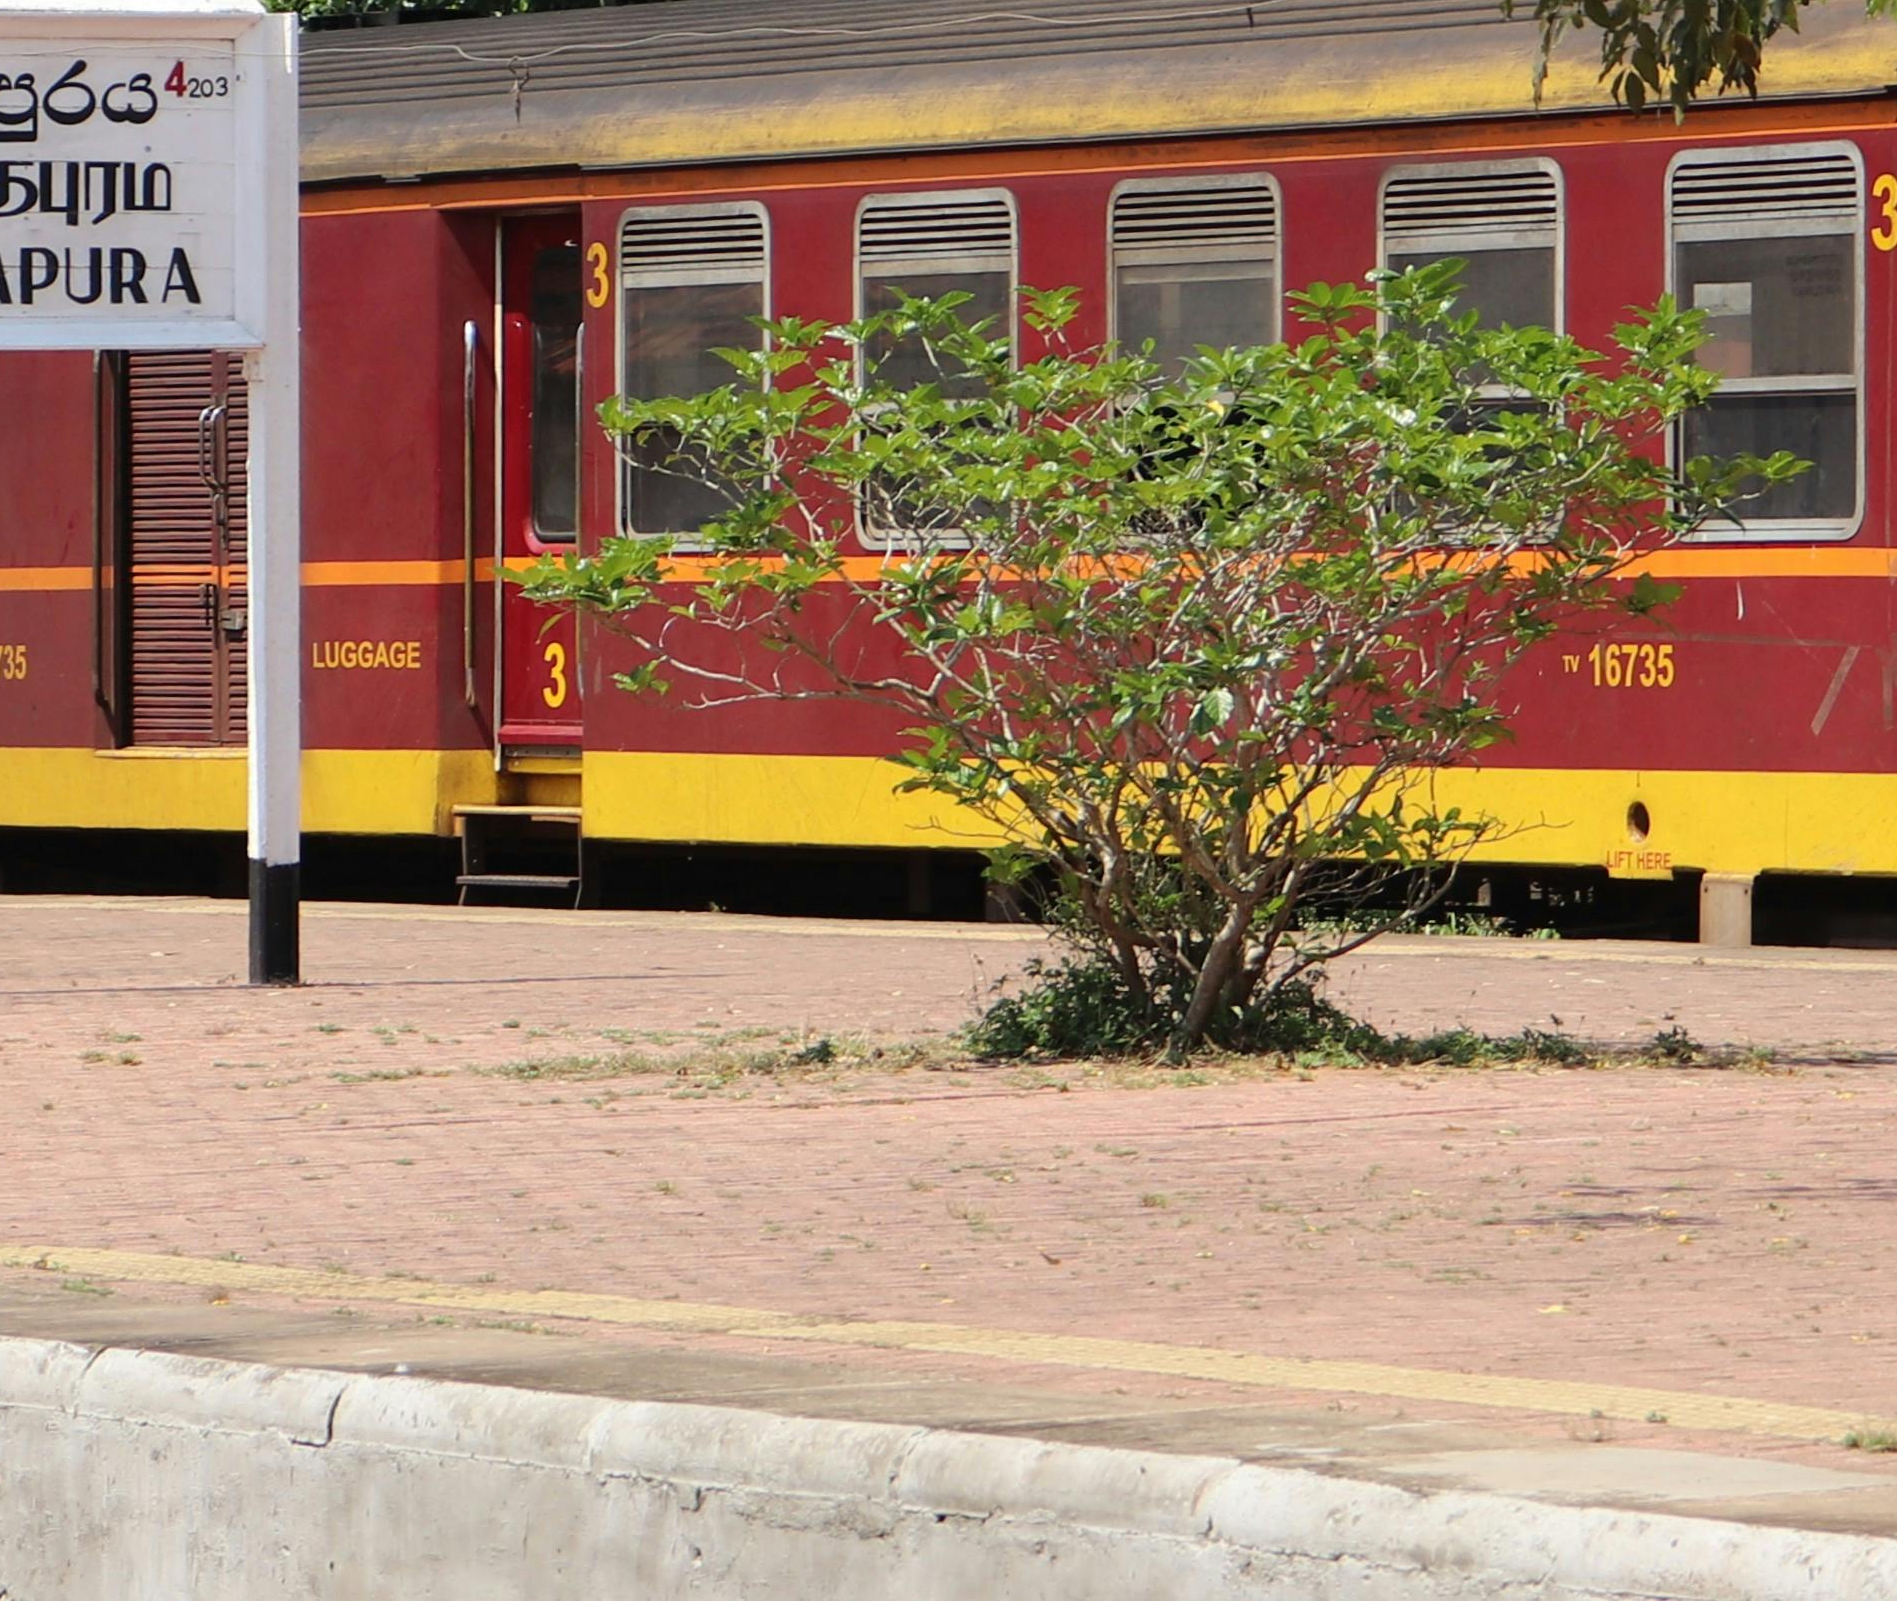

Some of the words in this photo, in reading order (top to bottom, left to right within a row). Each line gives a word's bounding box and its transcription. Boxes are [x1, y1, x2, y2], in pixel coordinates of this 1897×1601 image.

[586, 242, 609, 308] 3
[312, 640, 422, 669] LUGGAGE
[543, 642, 567, 708] 3
[1562, 654, 1581, 673] TV
[1588, 643, 1675, 688] 16735
[1606, 850, 1633, 869] LIFT
[1636, 852, 1671, 870] HERE
